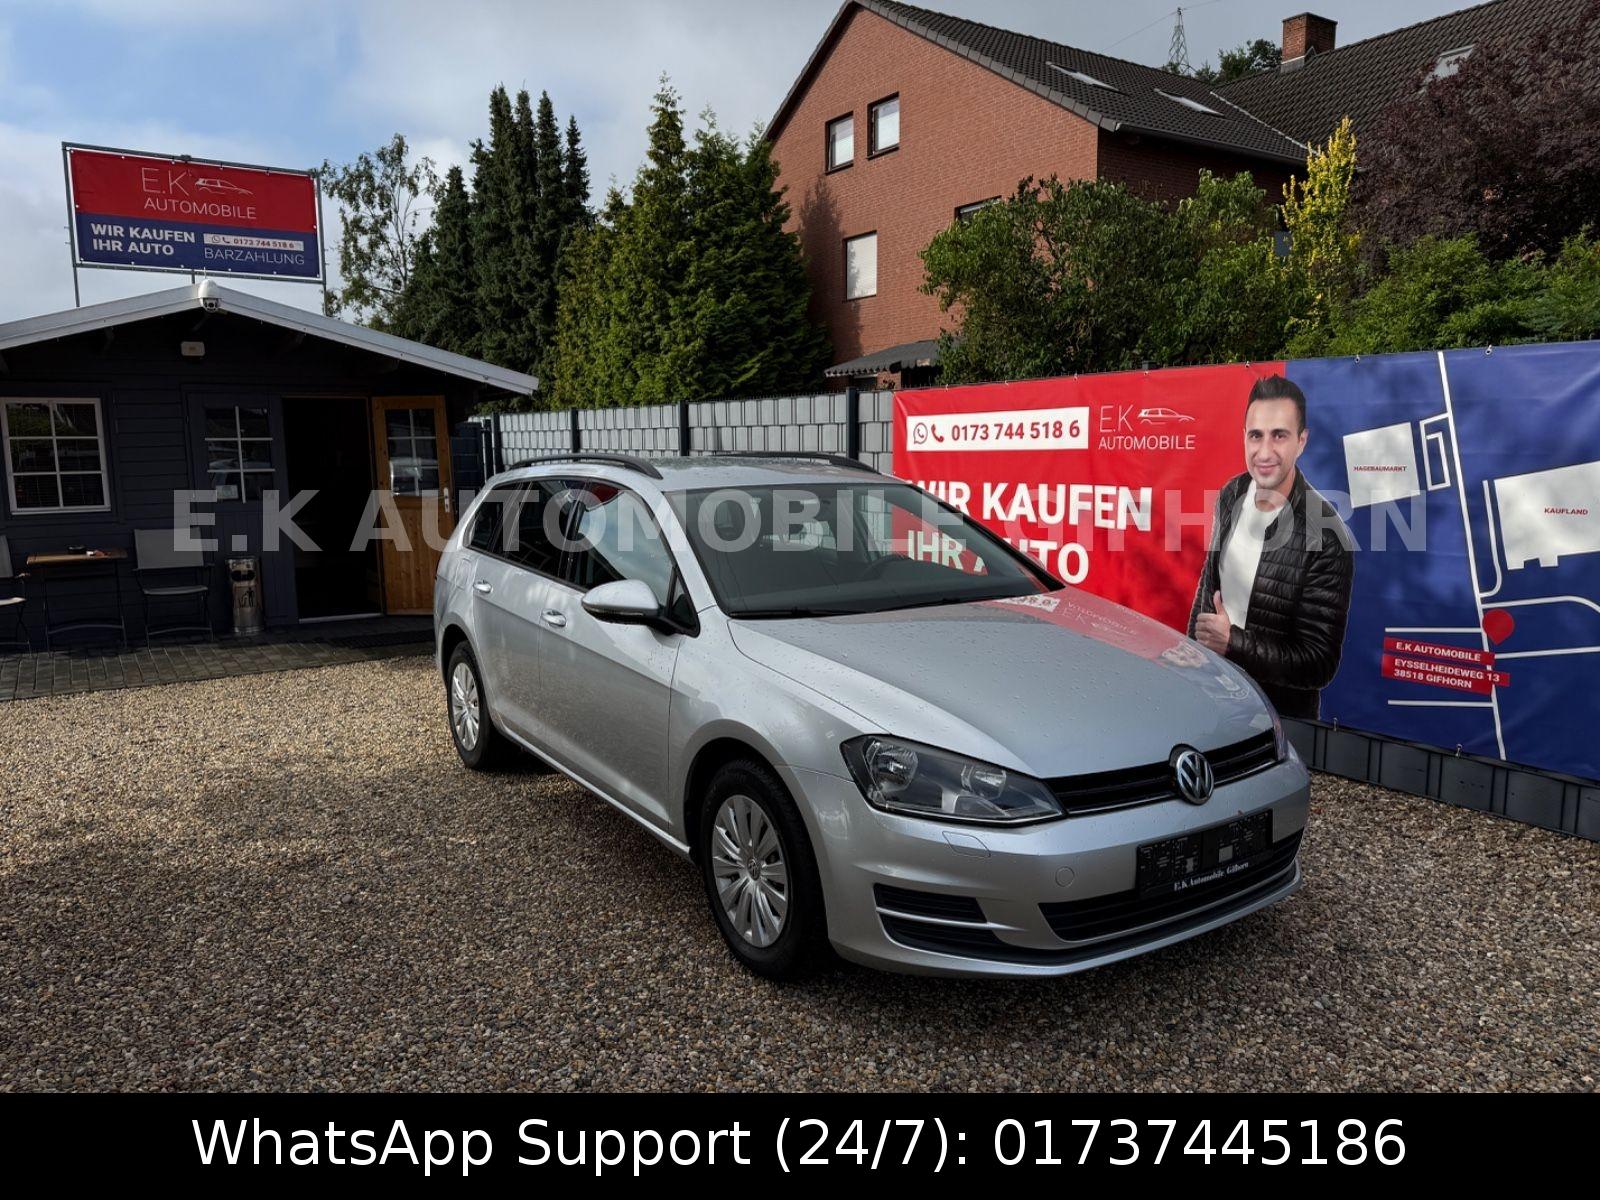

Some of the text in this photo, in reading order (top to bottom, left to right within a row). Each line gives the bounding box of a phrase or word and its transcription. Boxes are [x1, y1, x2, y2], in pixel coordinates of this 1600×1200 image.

[143, 197, 257, 220] AUTOMOBILE
[91, 222, 196, 243] WIR KAUFEN
[233, 238, 254, 246] 0173
[255, 239, 271, 247] 744
[93, 239, 175, 256] IHR AUTO
[204, 247, 305, 265] BARZAHLUNG
[1099, 404, 1134, 433] E.K
[951, 420, 1081, 442] 0173 744 518 6
[1098, 434, 1197, 450] AUTOMOBILE
[982, 481, 1153, 532] KAUFEN
[1543, 506, 1589, 516] KAUFLAND
[907, 530, 965, 571] IHR
[1395, 642, 1481, 662] E.K AUTOMOBILE
[1394, 658, 1500, 682] EYSSELHEIDEWEG 13
[1394, 669, 1472, 688] 38518 GIFHORN
